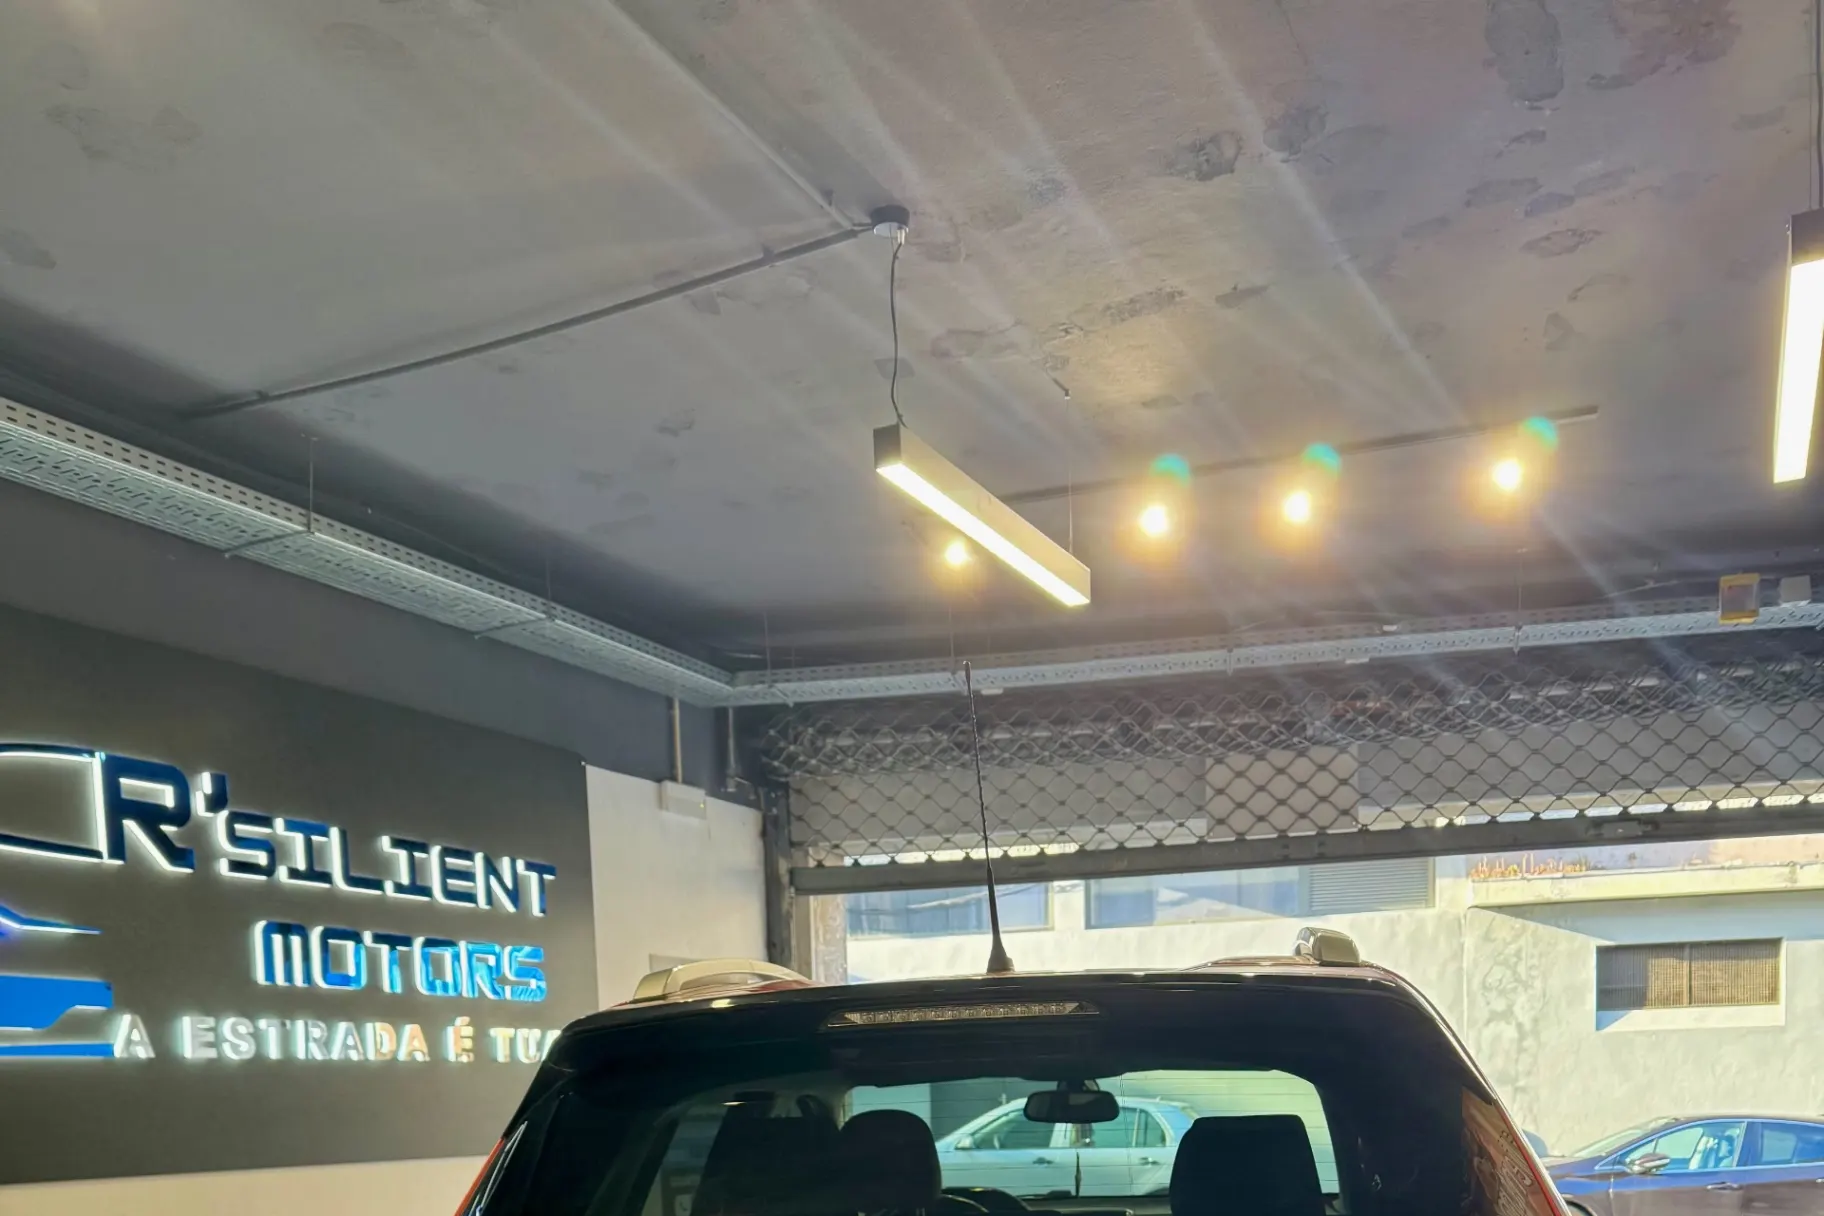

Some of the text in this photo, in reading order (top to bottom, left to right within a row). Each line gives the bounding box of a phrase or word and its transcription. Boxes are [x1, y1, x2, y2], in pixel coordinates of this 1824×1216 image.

[99, 751, 557, 917] R'SILIENT
[254, 919, 548, 1002] MOTORS
[113, 1013, 156, 1060] A
[181, 1015, 431, 1062] ESTRADA
[446, 1016, 475, 1063] É
